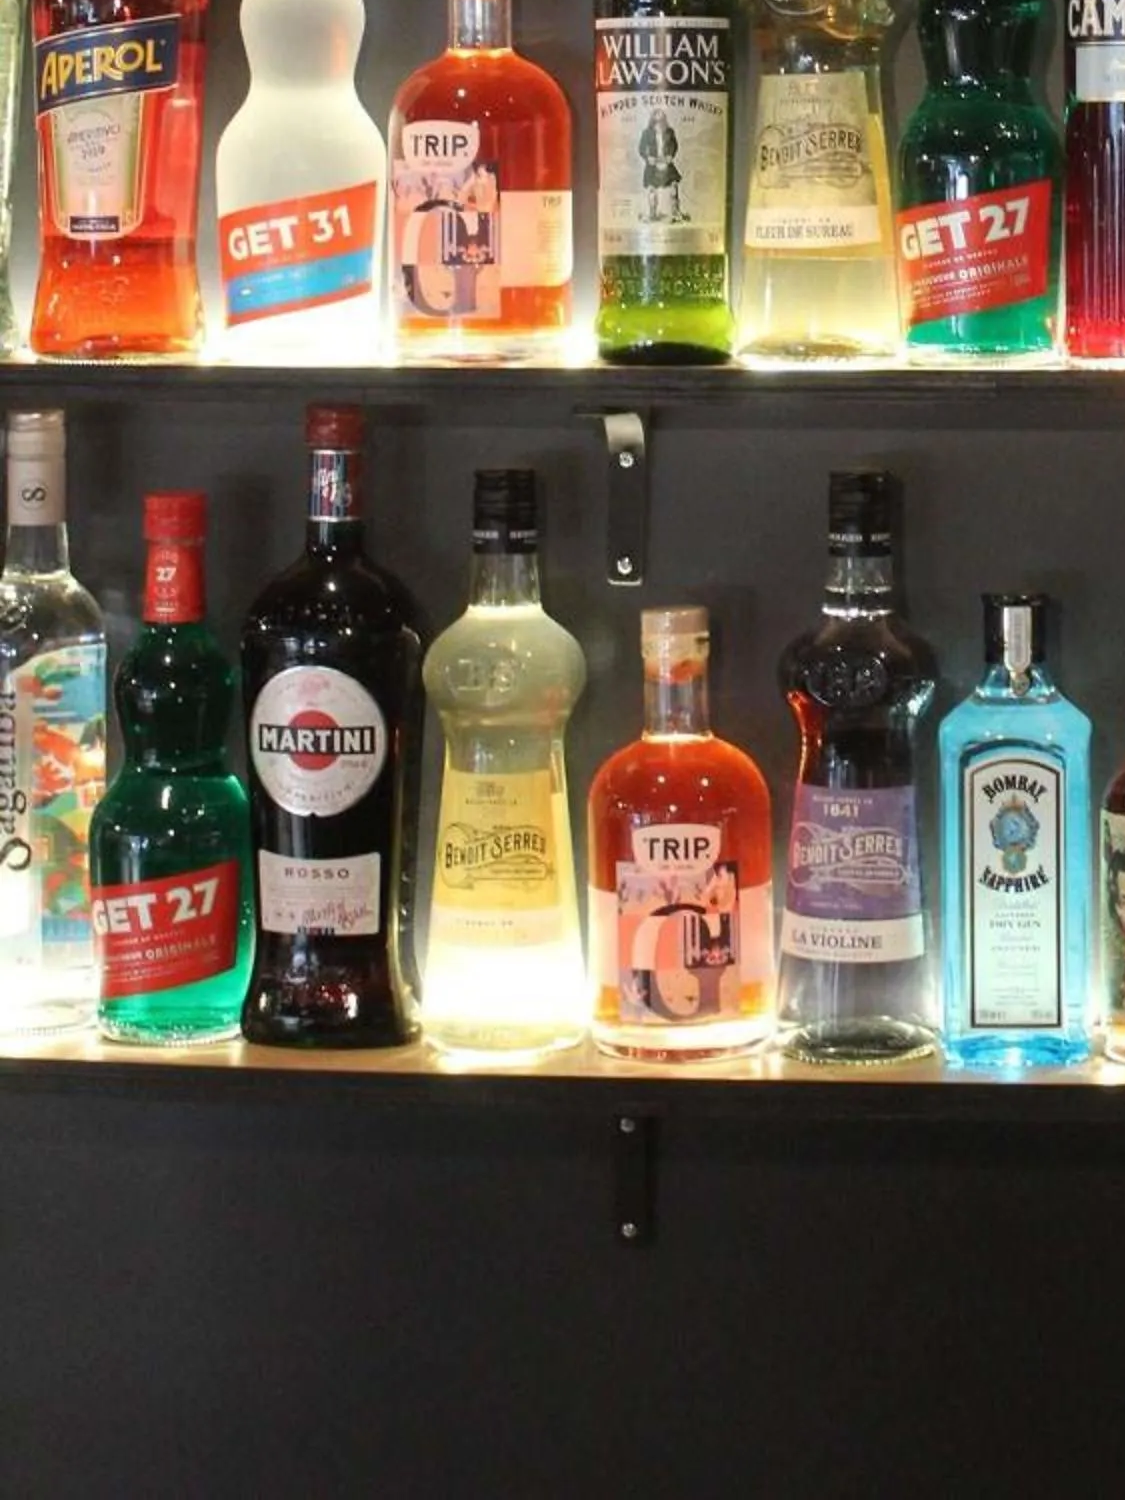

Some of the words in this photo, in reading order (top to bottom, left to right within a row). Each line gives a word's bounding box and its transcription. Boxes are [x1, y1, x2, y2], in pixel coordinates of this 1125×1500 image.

[603, 34, 718, 58] WILLIAM
[41, 39, 162, 99] APEROL
[596, 60, 725, 85] LAWSON'S
[641, 93, 685, 107] SCOTCH
[761, 139, 803, 171] BENOIT
[228, 215, 299, 261] GET
[308, 204, 352, 243] 31
[901, 210, 971, 260] GET
[979, 197, 1029, 243] 27
[262, 728, 371, 752] MARTINI
[982, 774, 1047, 804] BOMBAY
[824, 803, 860, 818] 1841
[446, 842, 486, 868] BENOIT
[285, 867, 349, 879] ROSSO
[979, 864, 1051, 894] SAPPHIRE
[92, 893, 157, 935] GET
[166, 878, 219, 924] 27
[810, 933, 883, 949] VIOLINE
